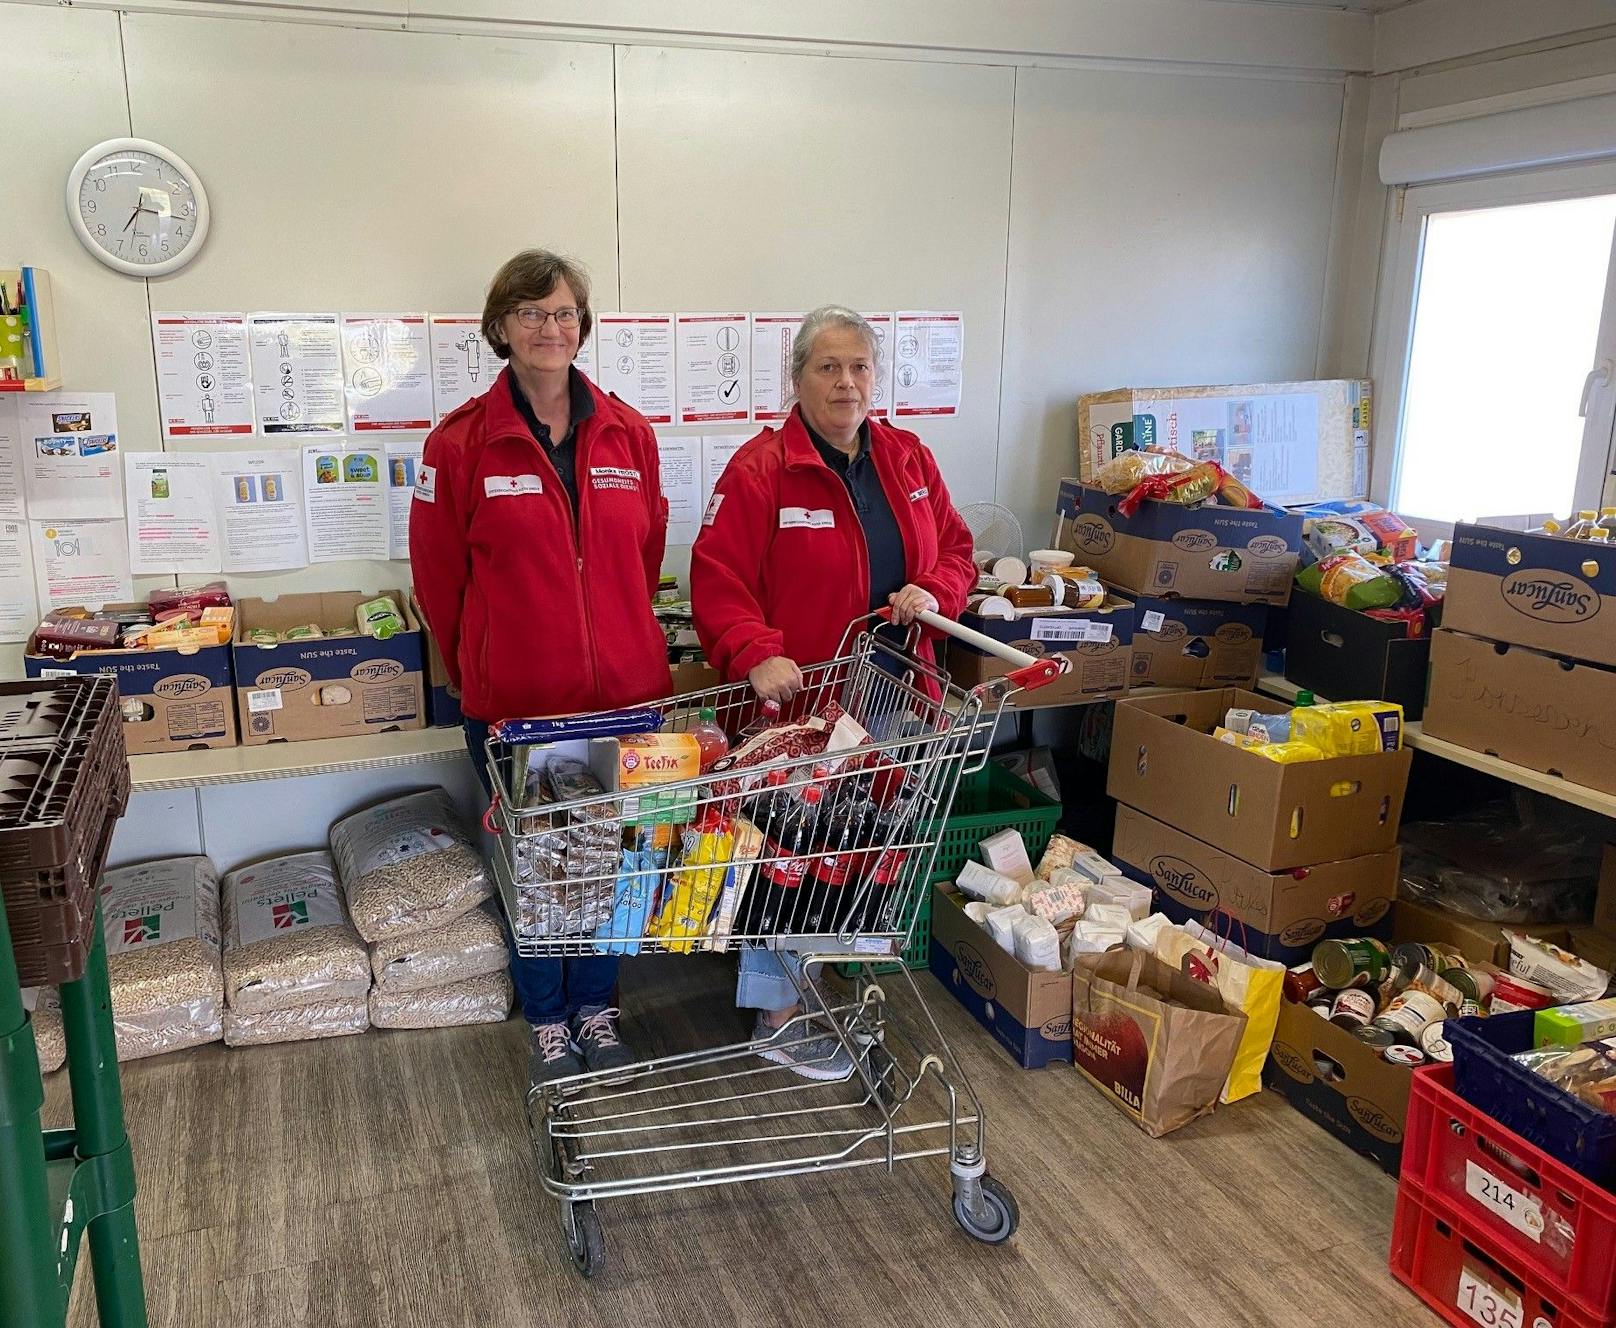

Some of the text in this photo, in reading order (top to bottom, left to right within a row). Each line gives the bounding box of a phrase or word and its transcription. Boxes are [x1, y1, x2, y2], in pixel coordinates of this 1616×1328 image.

[130, 160, 141, 172] 12
[156, 168, 162, 180] 1
[94, 179, 106, 193] 10
[171, 182, 182, 196] 2
[87, 199, 97, 213] 9
[180, 203, 190, 217] 3
[97, 223, 107, 236] 8
[175, 226, 183, 238] 4
[116, 239, 124, 252] 7
[138, 243, 148, 257] 6
[160, 239, 169, 252] 5
[1174, 532, 1216, 550] SanLucar
[1250, 538, 1287, 555] SanLucar
[1507, 580, 1591, 616] SanLucar
[300, 648, 358, 659] Taste the SUN
[99, 663, 160, 673] Taste the SUN
[354, 662, 402, 678] SanLucar
[158, 677, 207, 696] SanLucar
[259, 670, 308, 688] SanLucar
[643, 755, 679, 770] TeeFix
[1154, 861, 1215, 903] SanLucar
[256, 889, 319, 909] Pellets
[110, 901, 175, 920] Pellets
[1073, 1017, 1122, 1056] EGIONALITÄT
[1113, 1080, 1141, 1109] BILLA
[1350, 1099, 1399, 1138] SanLucar
[1481, 1176, 1516, 1211] 214
[1465, 1284, 1517, 1328] 135
